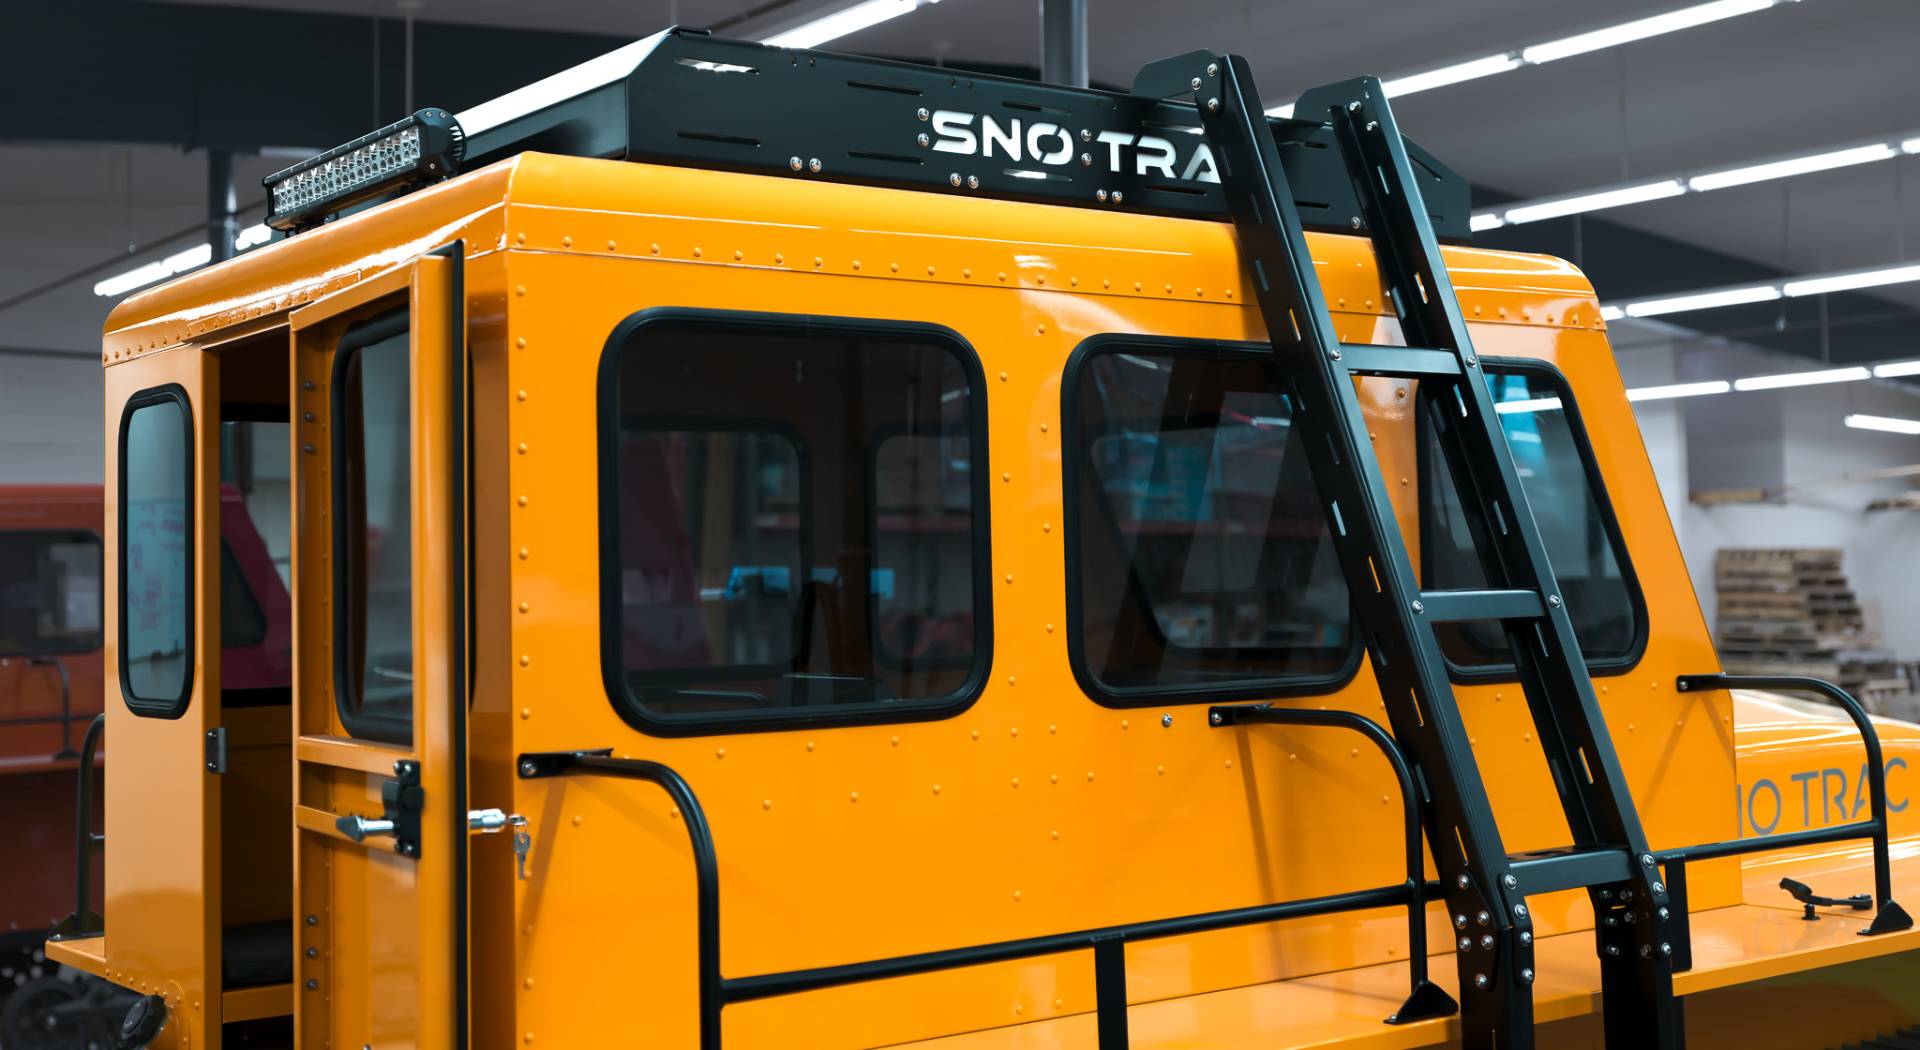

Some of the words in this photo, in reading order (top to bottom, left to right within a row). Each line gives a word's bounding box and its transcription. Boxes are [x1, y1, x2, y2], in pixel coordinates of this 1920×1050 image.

[932, 110, 1074, 165] SNO
[1097, 131, 1222, 184] TRA
[1791, 757, 1910, 827] TRAC
